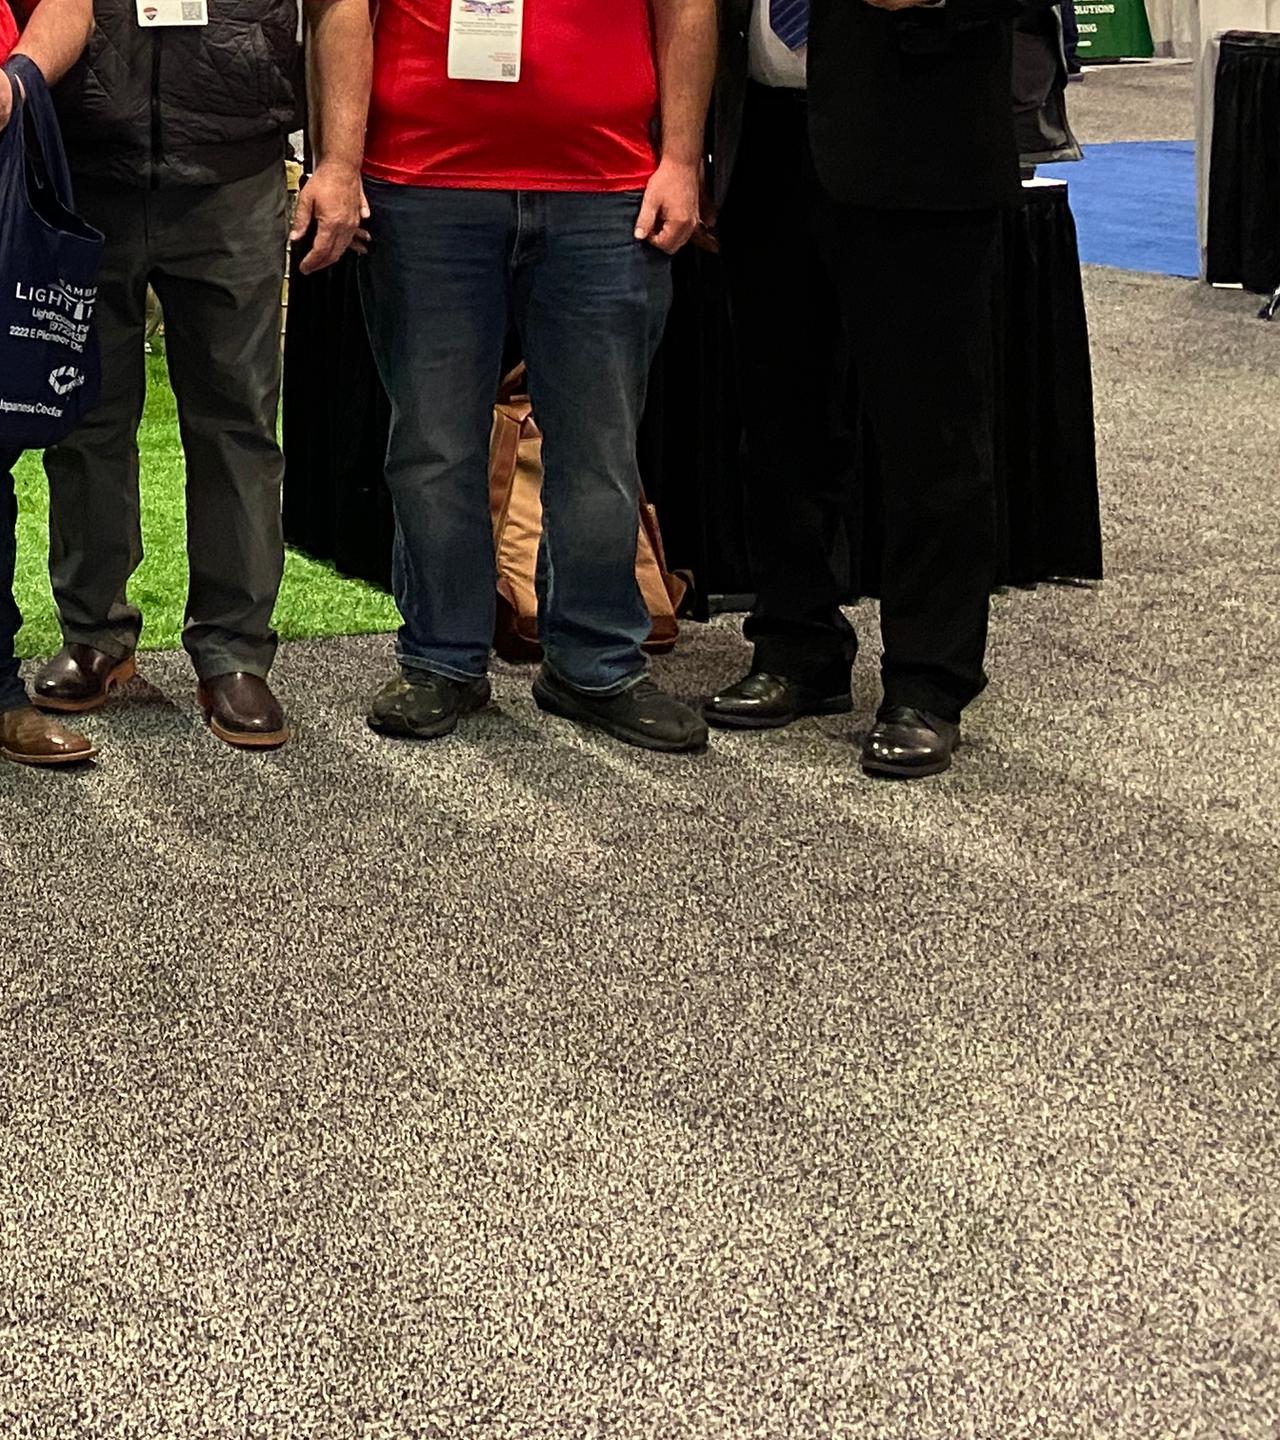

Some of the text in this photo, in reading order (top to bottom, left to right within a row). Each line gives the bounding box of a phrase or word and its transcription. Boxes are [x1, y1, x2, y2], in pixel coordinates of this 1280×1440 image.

[1074, 4, 1115, 15] OLUTIONS
[9, 325, 29, 337] 2222
[30, 328, 36, 338] E
